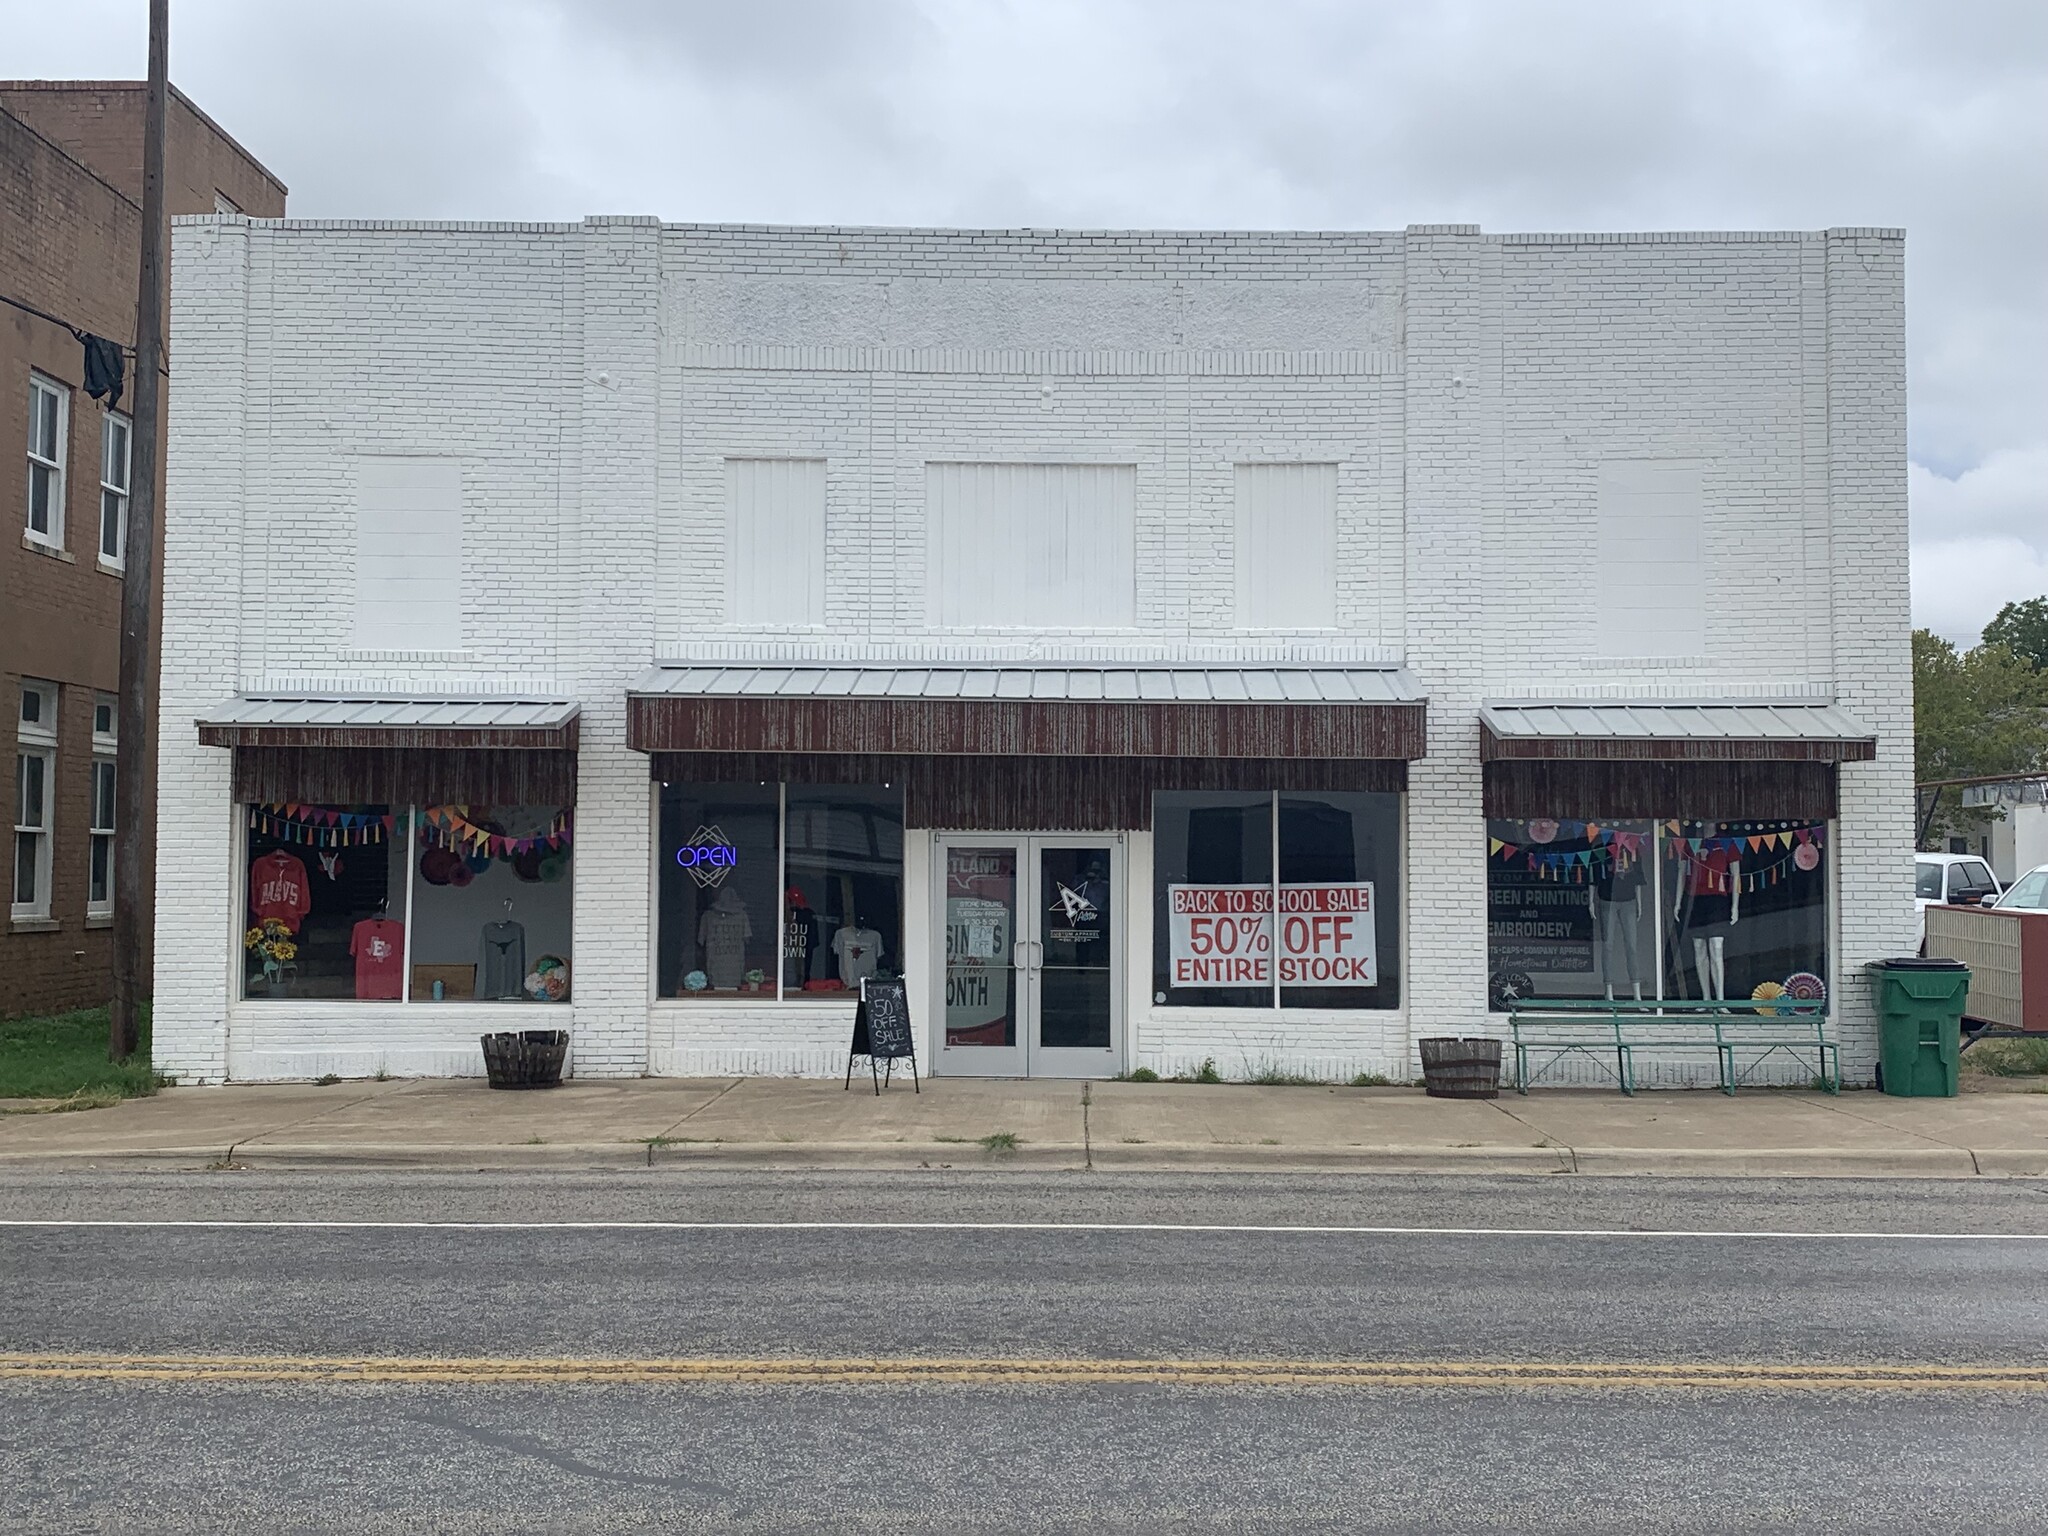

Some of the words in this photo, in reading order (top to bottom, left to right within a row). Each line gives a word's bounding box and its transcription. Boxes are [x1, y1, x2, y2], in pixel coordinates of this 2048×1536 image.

[677, 846, 736, 867] OPEN
[261, 881, 298, 906] MAVS
[1175, 890, 1219, 912] BACK
[1225, 890, 1246, 912] TO
[1252, 889, 1321, 911] SCHOOL
[1327, 889, 1368, 911] SALE
[1526, 889, 1589, 906] PRINTING
[1519, 910, 1538, 918] AND
[1191, 916, 1270, 954] 50%
[1284, 916, 1353, 955] OFF
[373, 941, 385, 956] E
[1559, 946, 1590, 955] APPAREL
[1177, 958, 1268, 981] ENTIRE
[1280, 957, 1369, 981] STOCK
[1499, 956, 1548, 969] Hometown
[1490, 973, 1532, 989] WELCOME
[873, 1015, 897, 1029] OFF
[875, 1029, 905, 1044] SALE
